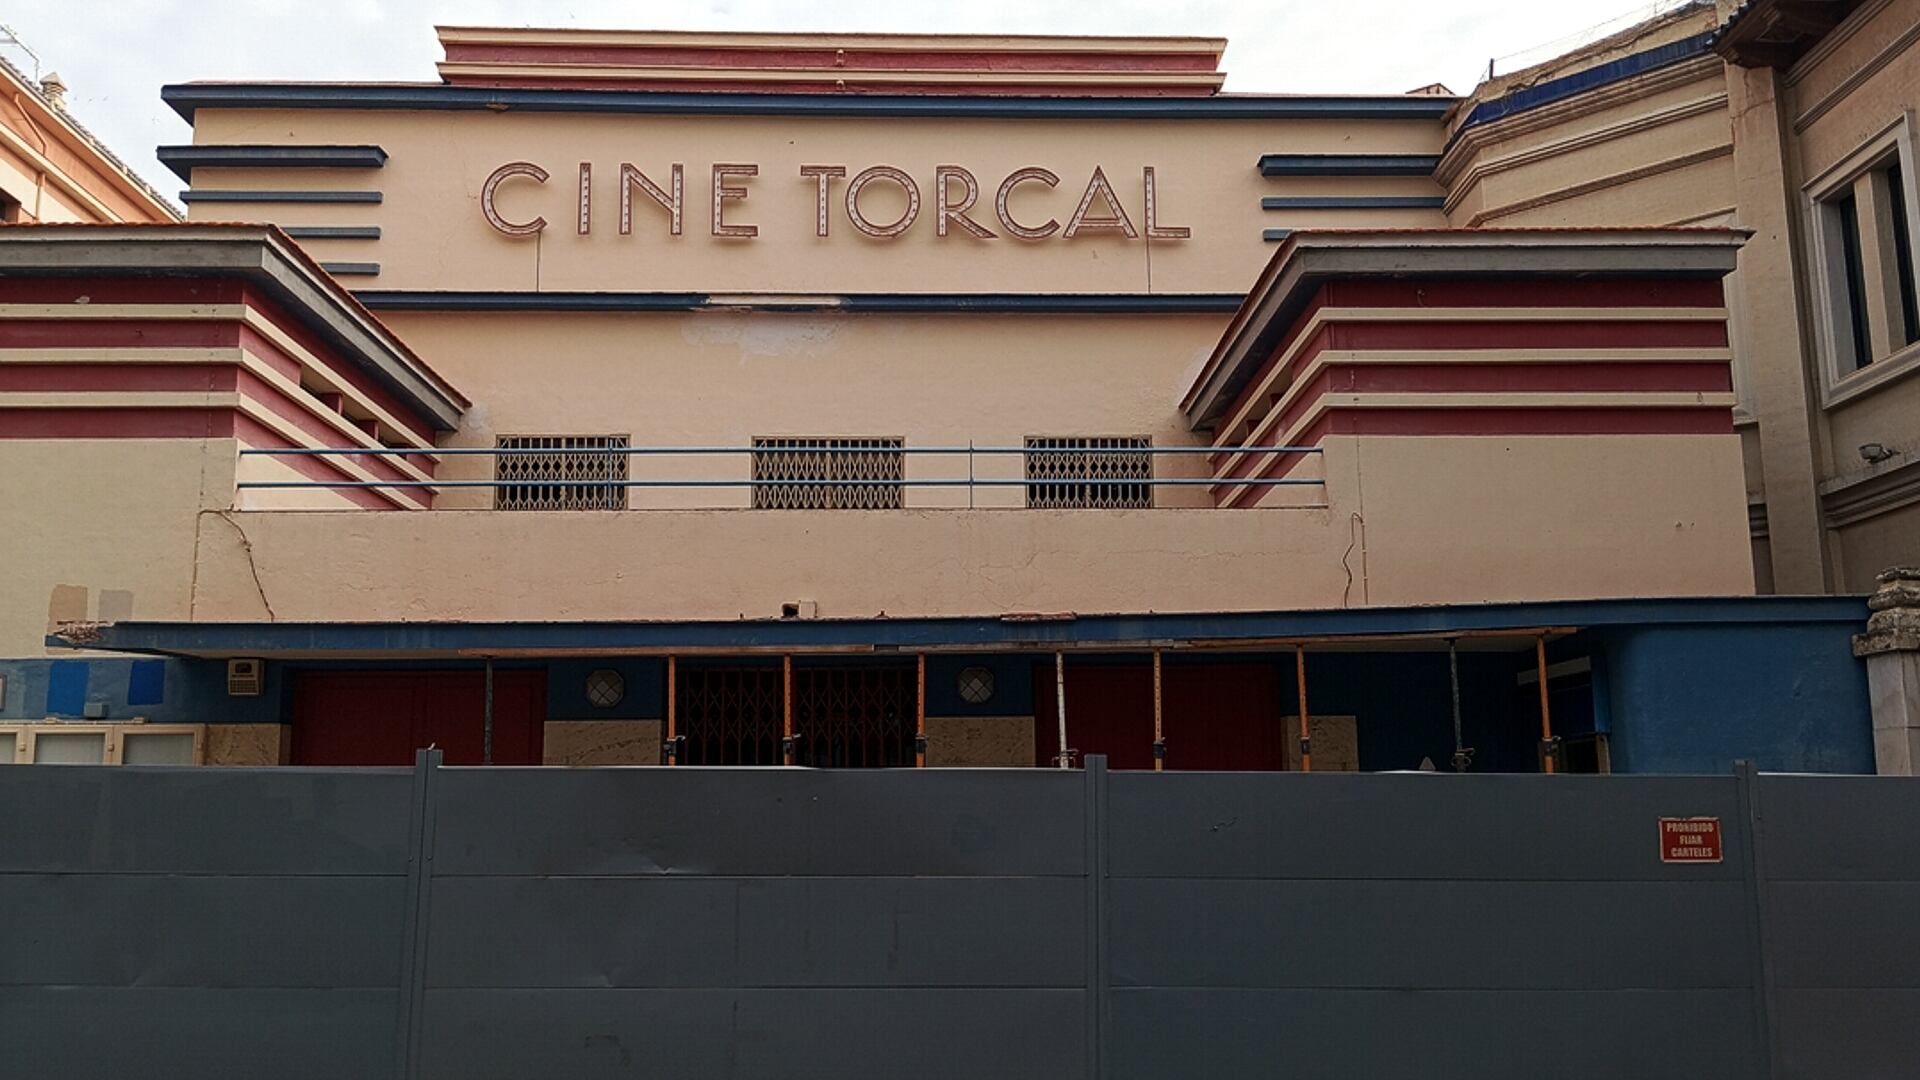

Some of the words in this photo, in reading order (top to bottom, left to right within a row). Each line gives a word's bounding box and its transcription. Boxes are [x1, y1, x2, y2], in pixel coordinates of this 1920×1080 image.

[481, 162, 758, 236] CINE
[800, 164, 1191, 239] TORCAL
[1666, 822, 1714, 833] PROHIBIDO
[1680, 835, 1703, 845] FIJAR
[1671, 847, 1713, 857] CARTELES
